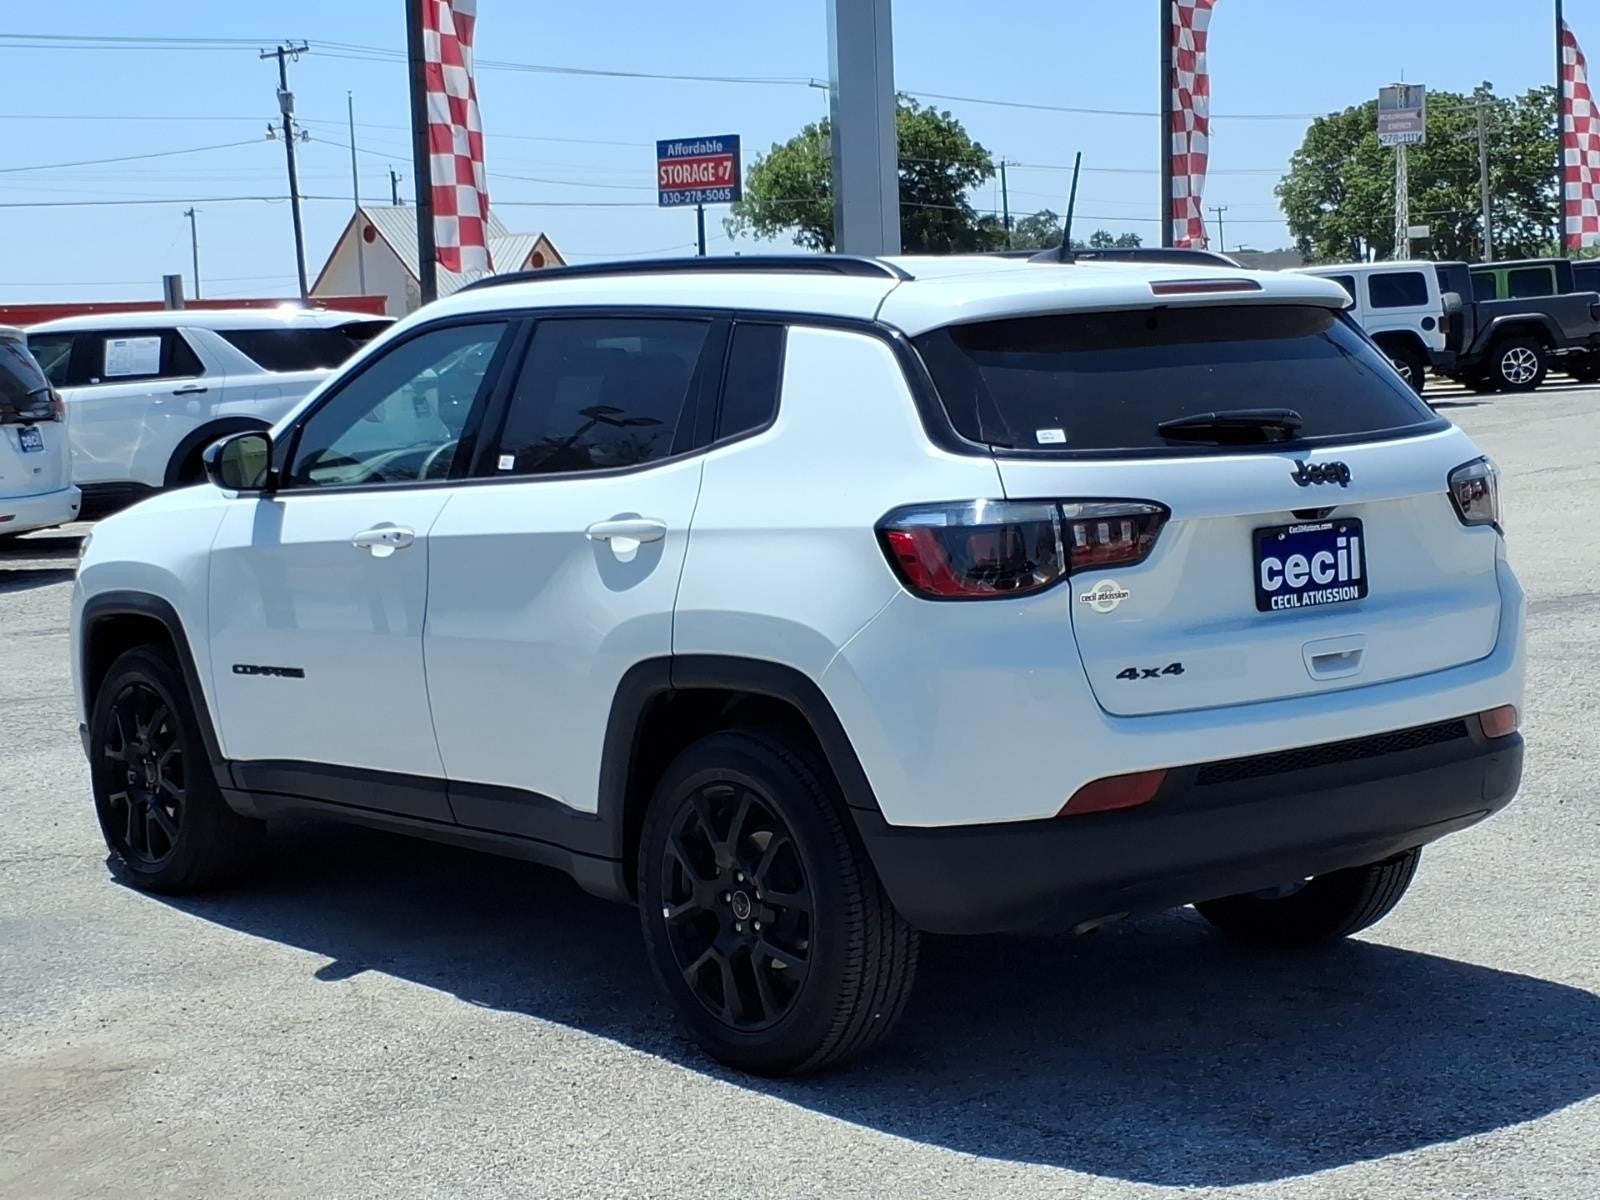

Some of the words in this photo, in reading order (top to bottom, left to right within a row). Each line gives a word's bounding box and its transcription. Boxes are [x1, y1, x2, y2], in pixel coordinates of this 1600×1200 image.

[667, 140, 723, 156] Affordable
[660, 162, 716, 185] STORAGE
[662, 189, 731, 204] 830-278-5065
[1291, 459, 1350, 488] Jeep
[1261, 537, 1361, 591] cecil
[1081, 593, 1097, 602] cecil
[1271, 594, 1301, 610] CECIL
[1302, 586, 1359, 606] ATKISSION
[1116, 662, 1185, 680] 4x4
